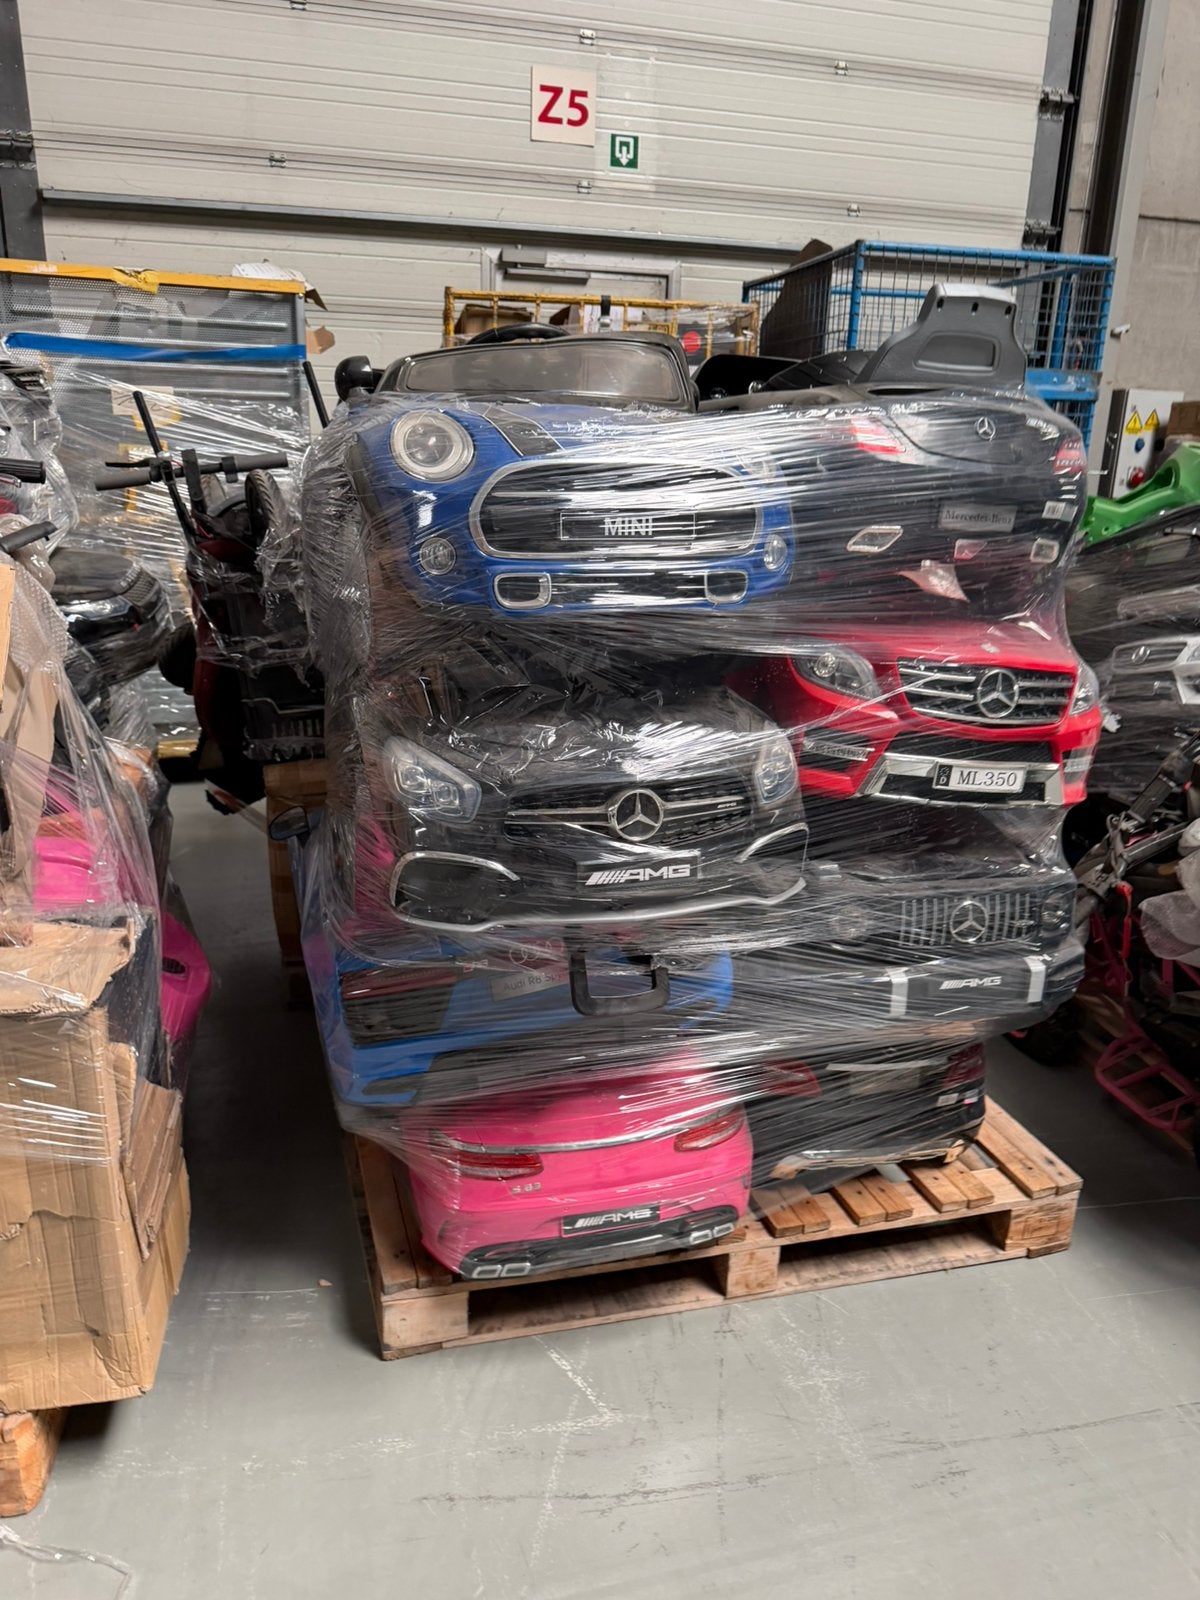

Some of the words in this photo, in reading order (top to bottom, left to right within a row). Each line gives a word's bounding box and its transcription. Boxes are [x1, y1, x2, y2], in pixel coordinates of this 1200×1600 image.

[538, 84, 589, 127] Z5
[604, 517, 653, 536] MINI
[957, 770, 1017, 787] ML350
[622, 864, 691, 882] AMG
[600, 1208, 652, 1224] AMG
